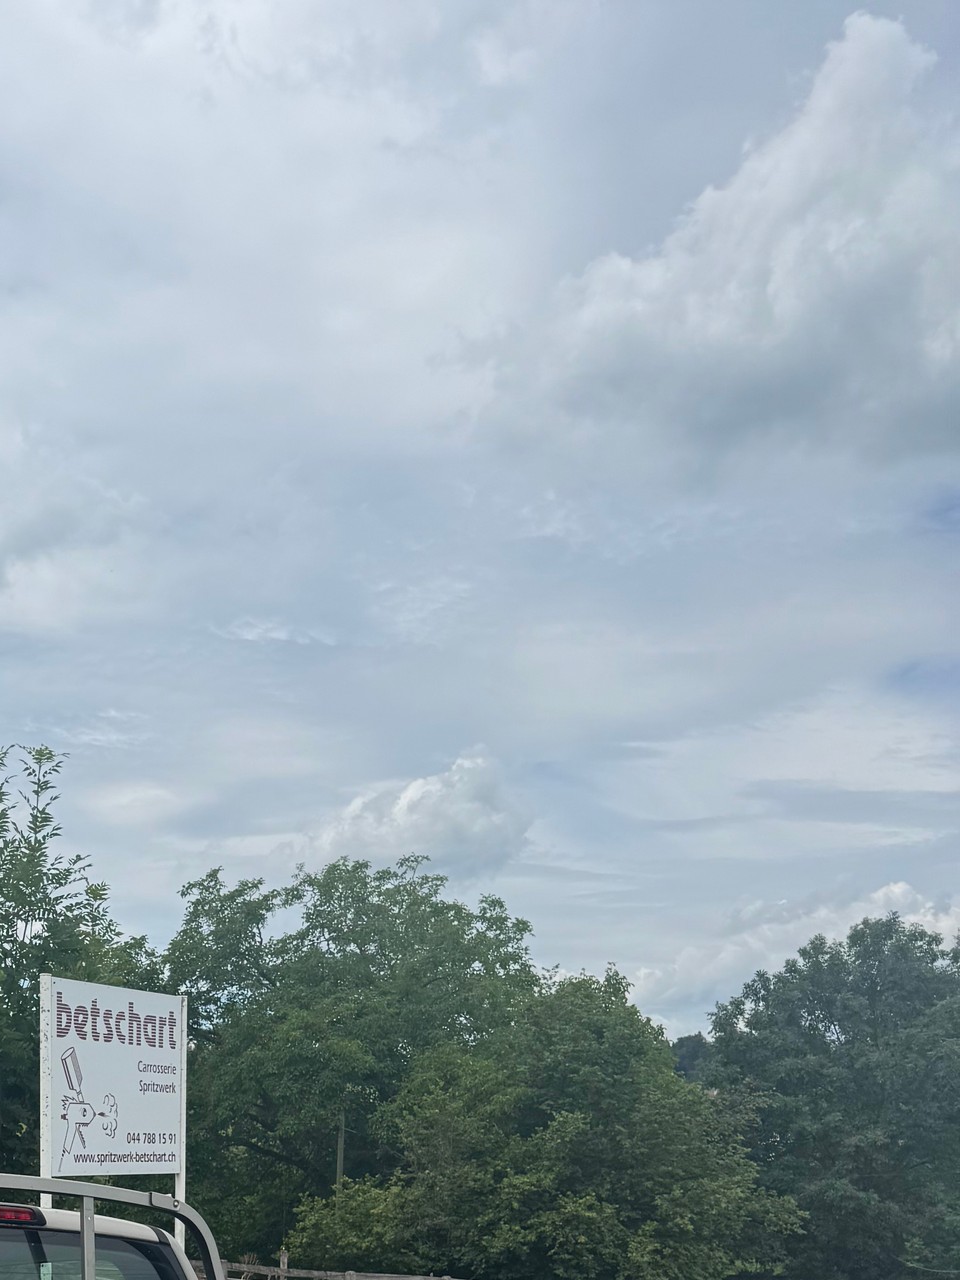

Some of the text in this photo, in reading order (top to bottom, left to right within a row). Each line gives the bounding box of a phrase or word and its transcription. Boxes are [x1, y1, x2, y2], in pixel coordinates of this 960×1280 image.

[56, 991, 177, 1050] betschart
[137, 1061, 177, 1075] Carrosserie
[139, 1080, 177, 1094] Spritzwerk
[126, 1132, 177, 1145] 044 788 15 91
[73, 1152, 177, 1166] www.spritzwerk-betschart.ch
